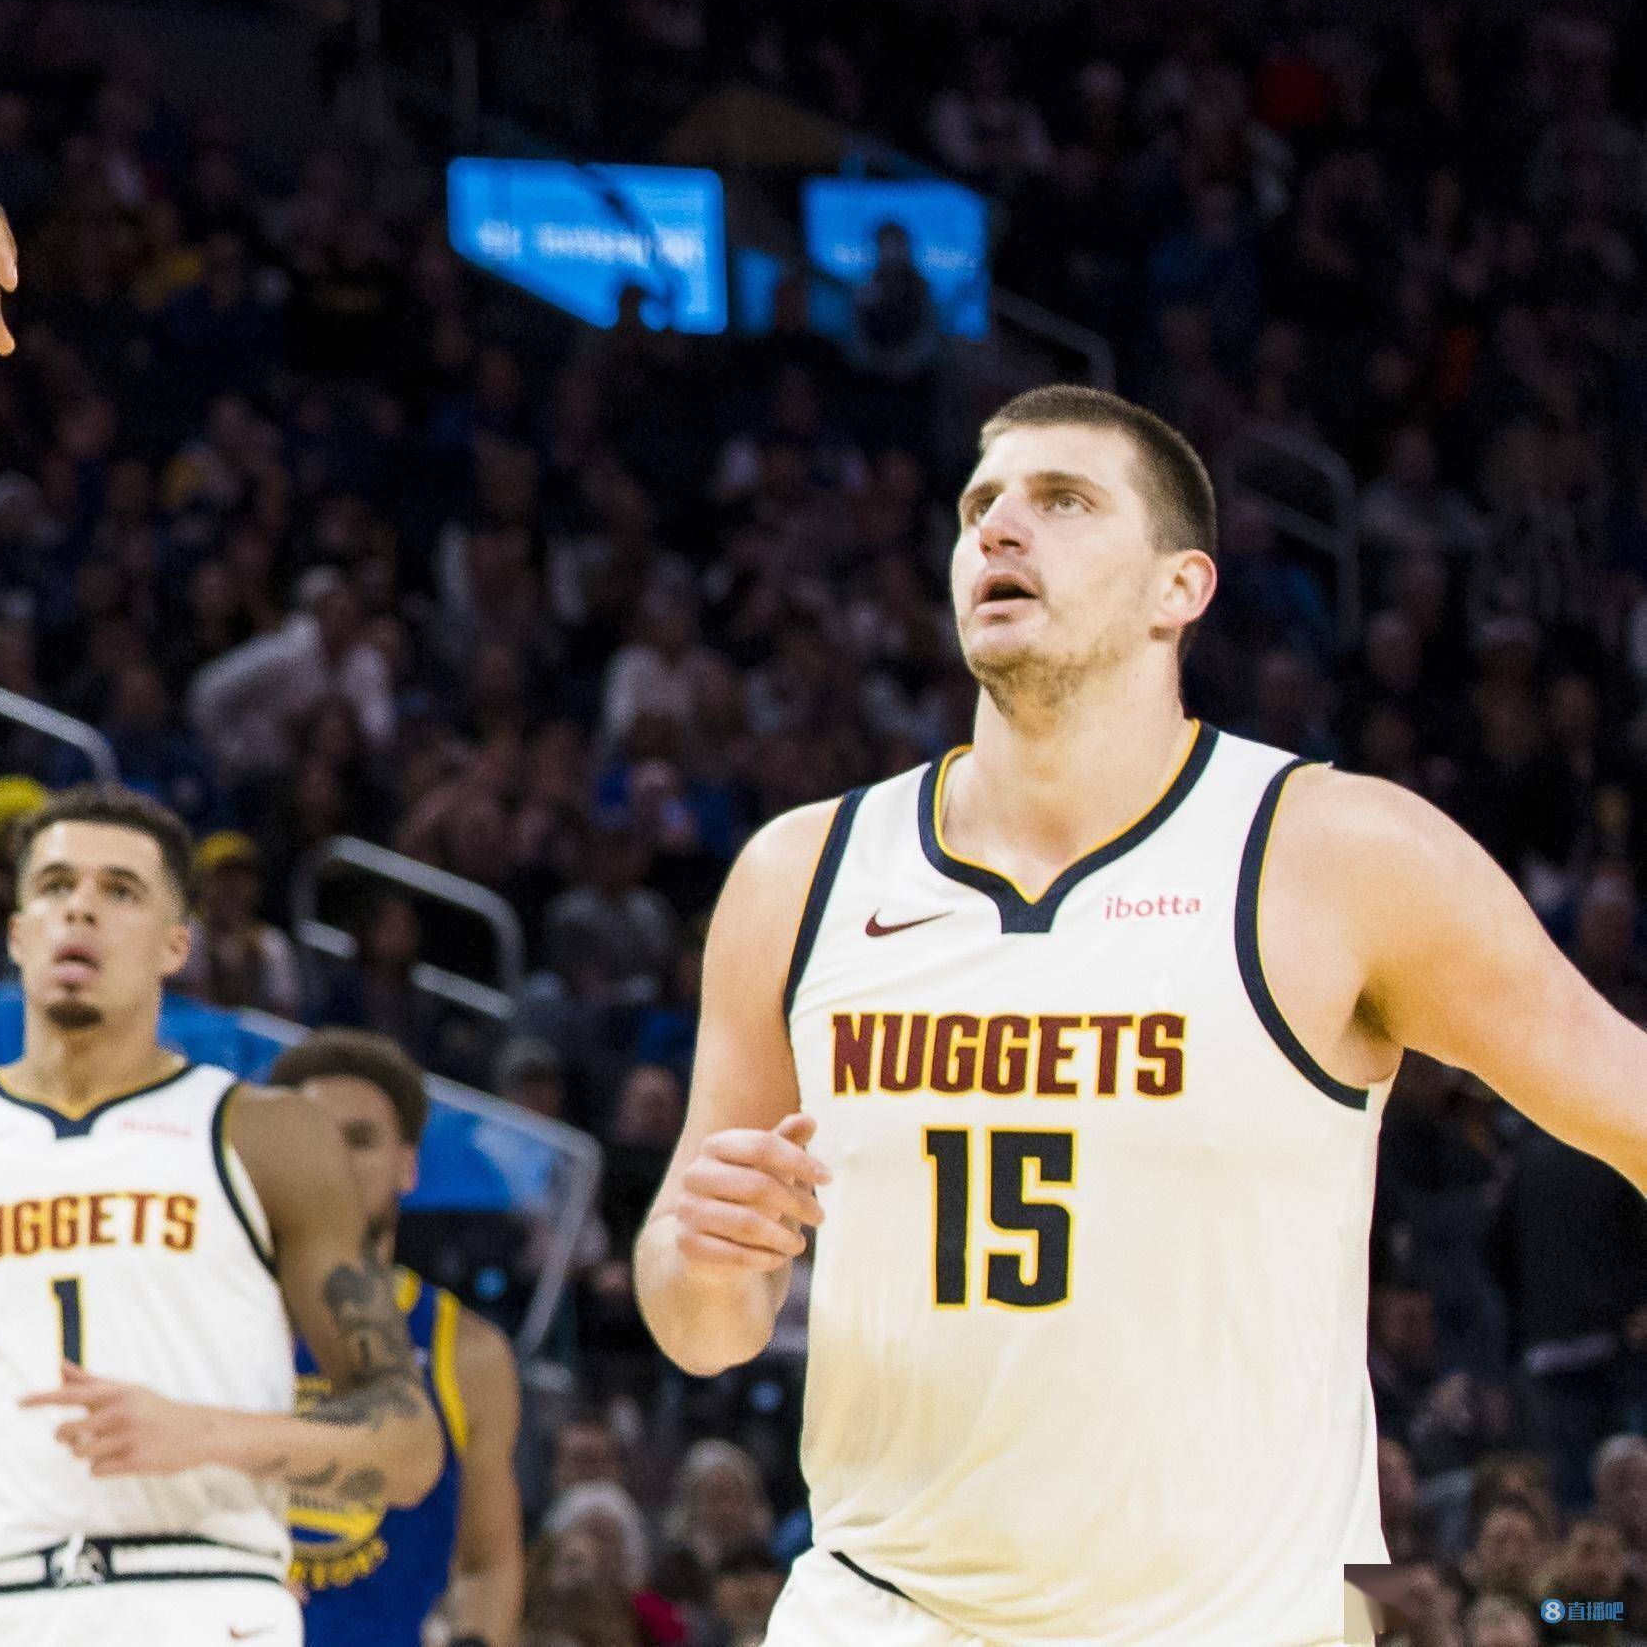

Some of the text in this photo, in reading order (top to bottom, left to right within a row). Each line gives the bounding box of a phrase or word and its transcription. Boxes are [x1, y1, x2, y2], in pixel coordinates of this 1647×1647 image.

[1105, 896, 1201, 920] ibotta
[831, 1012, 1186, 1097] NUGGETS
[920, 1125, 1076, 1311] 15
[51, 1273, 85, 1368] 1
